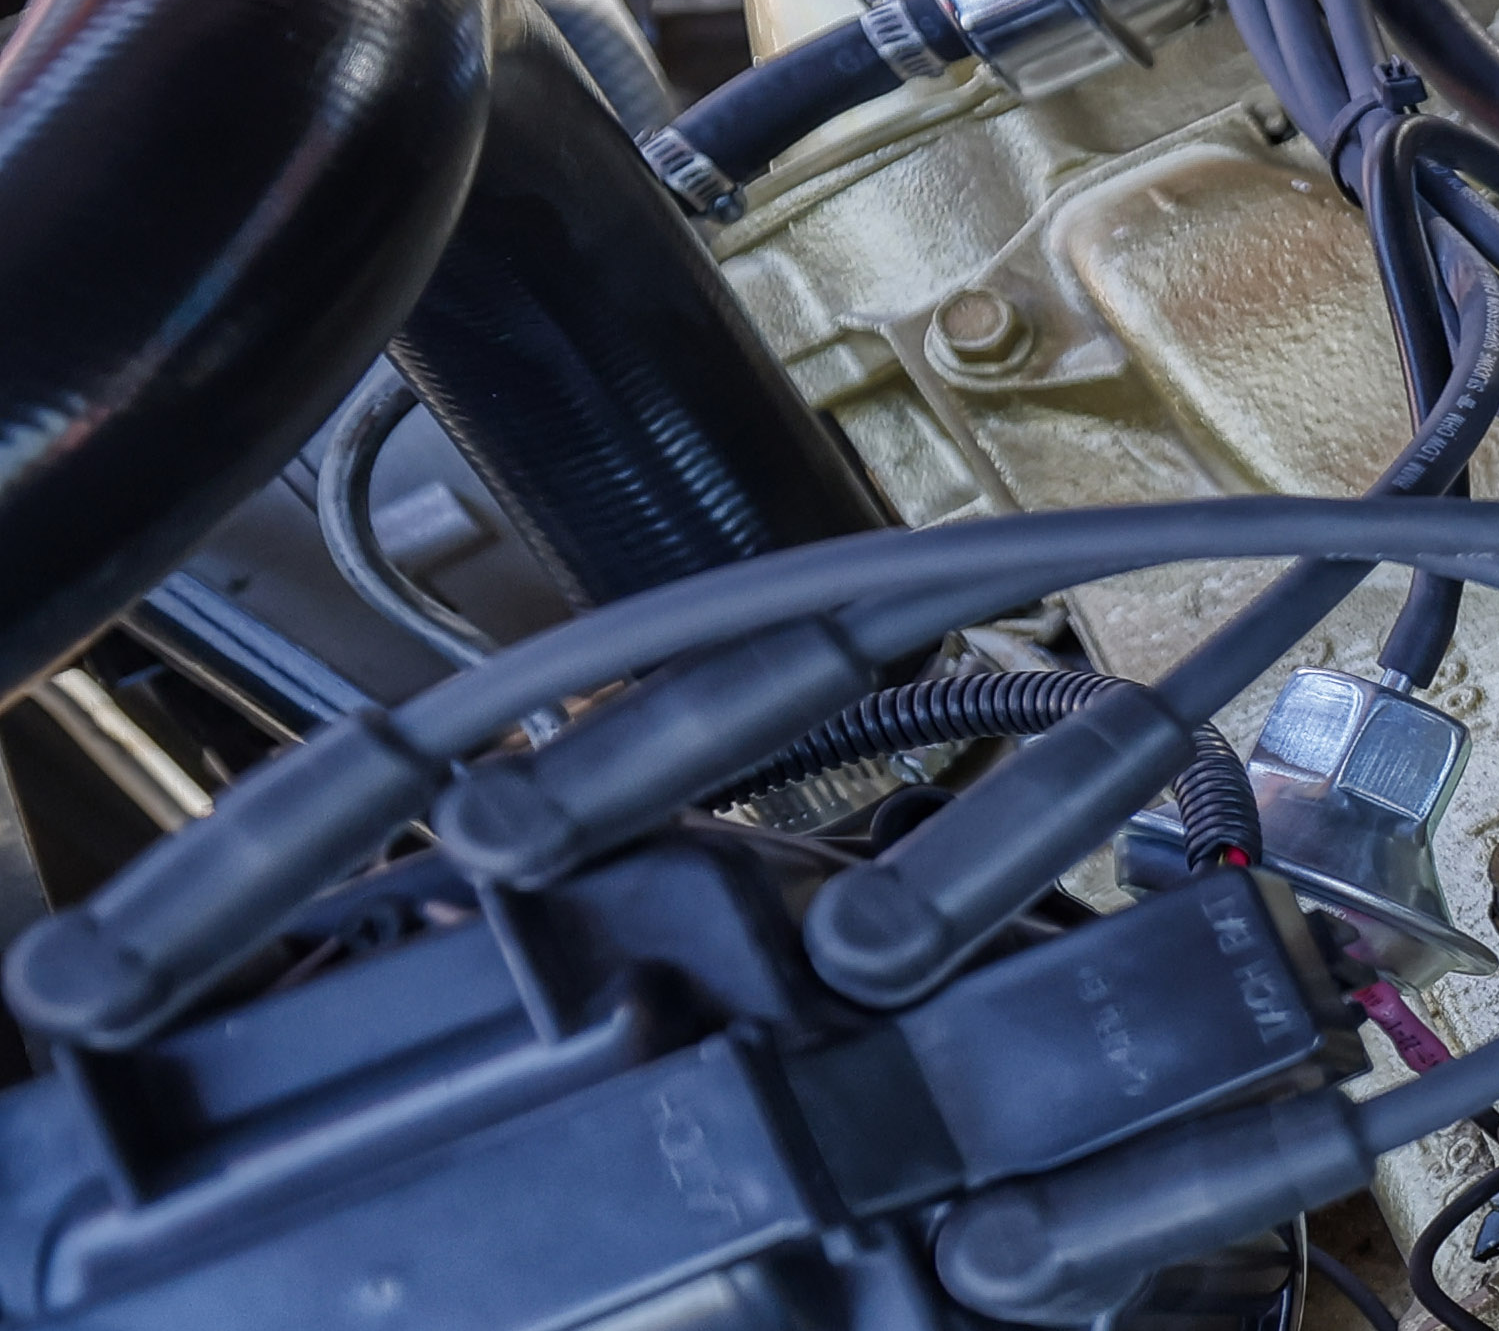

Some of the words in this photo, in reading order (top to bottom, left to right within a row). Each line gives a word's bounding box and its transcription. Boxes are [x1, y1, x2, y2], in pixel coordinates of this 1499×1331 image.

[1419, 434, 1448, 463] LOW
[1441, 411, 1467, 439] OHM
[1465, 351, 1499, 394] SILICONE
[1233, 958, 1293, 1046] TACH
